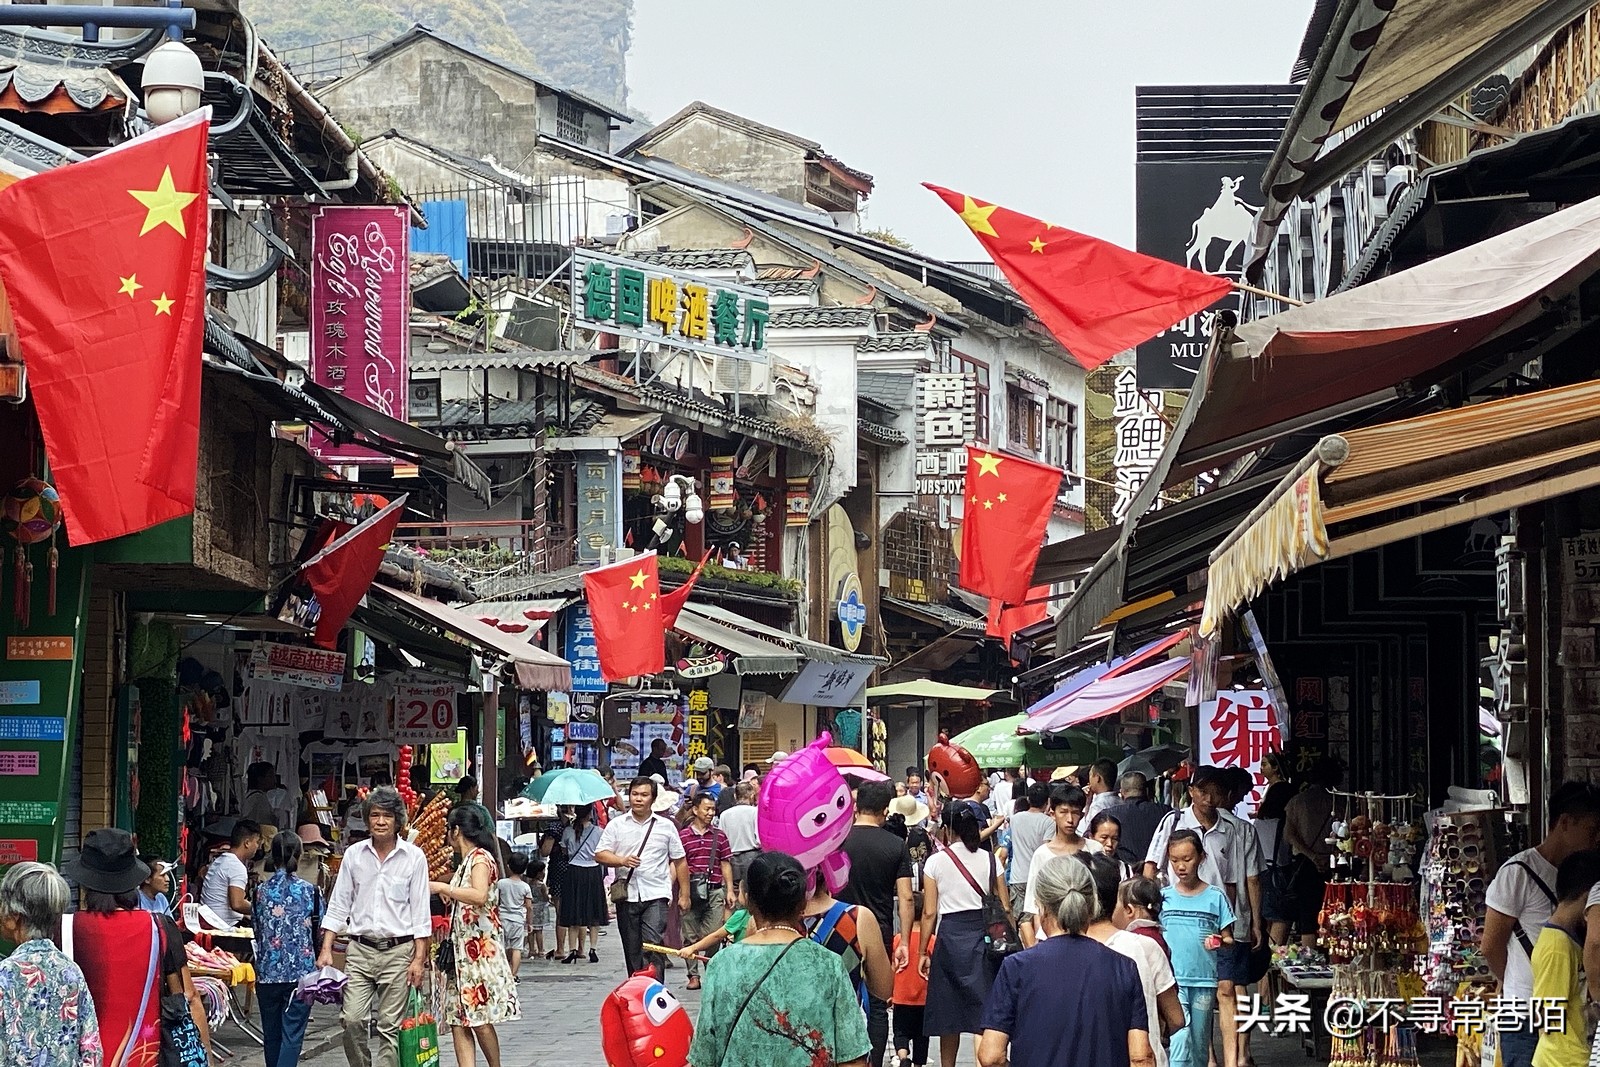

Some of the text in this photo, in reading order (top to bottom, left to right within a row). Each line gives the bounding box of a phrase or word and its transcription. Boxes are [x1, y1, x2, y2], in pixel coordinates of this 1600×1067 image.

[363, 221, 395, 374] Rosewood
[581, 260, 770, 350] 德国啤酒餐厅
[1170, 343, 1208, 358] MU
[916, 451, 969, 475] 酒吧
[1566, 537, 1600, 557] 百家姓
[268, 645, 346, 675] 越南拖鞋
[406, 699, 453, 730] 20
